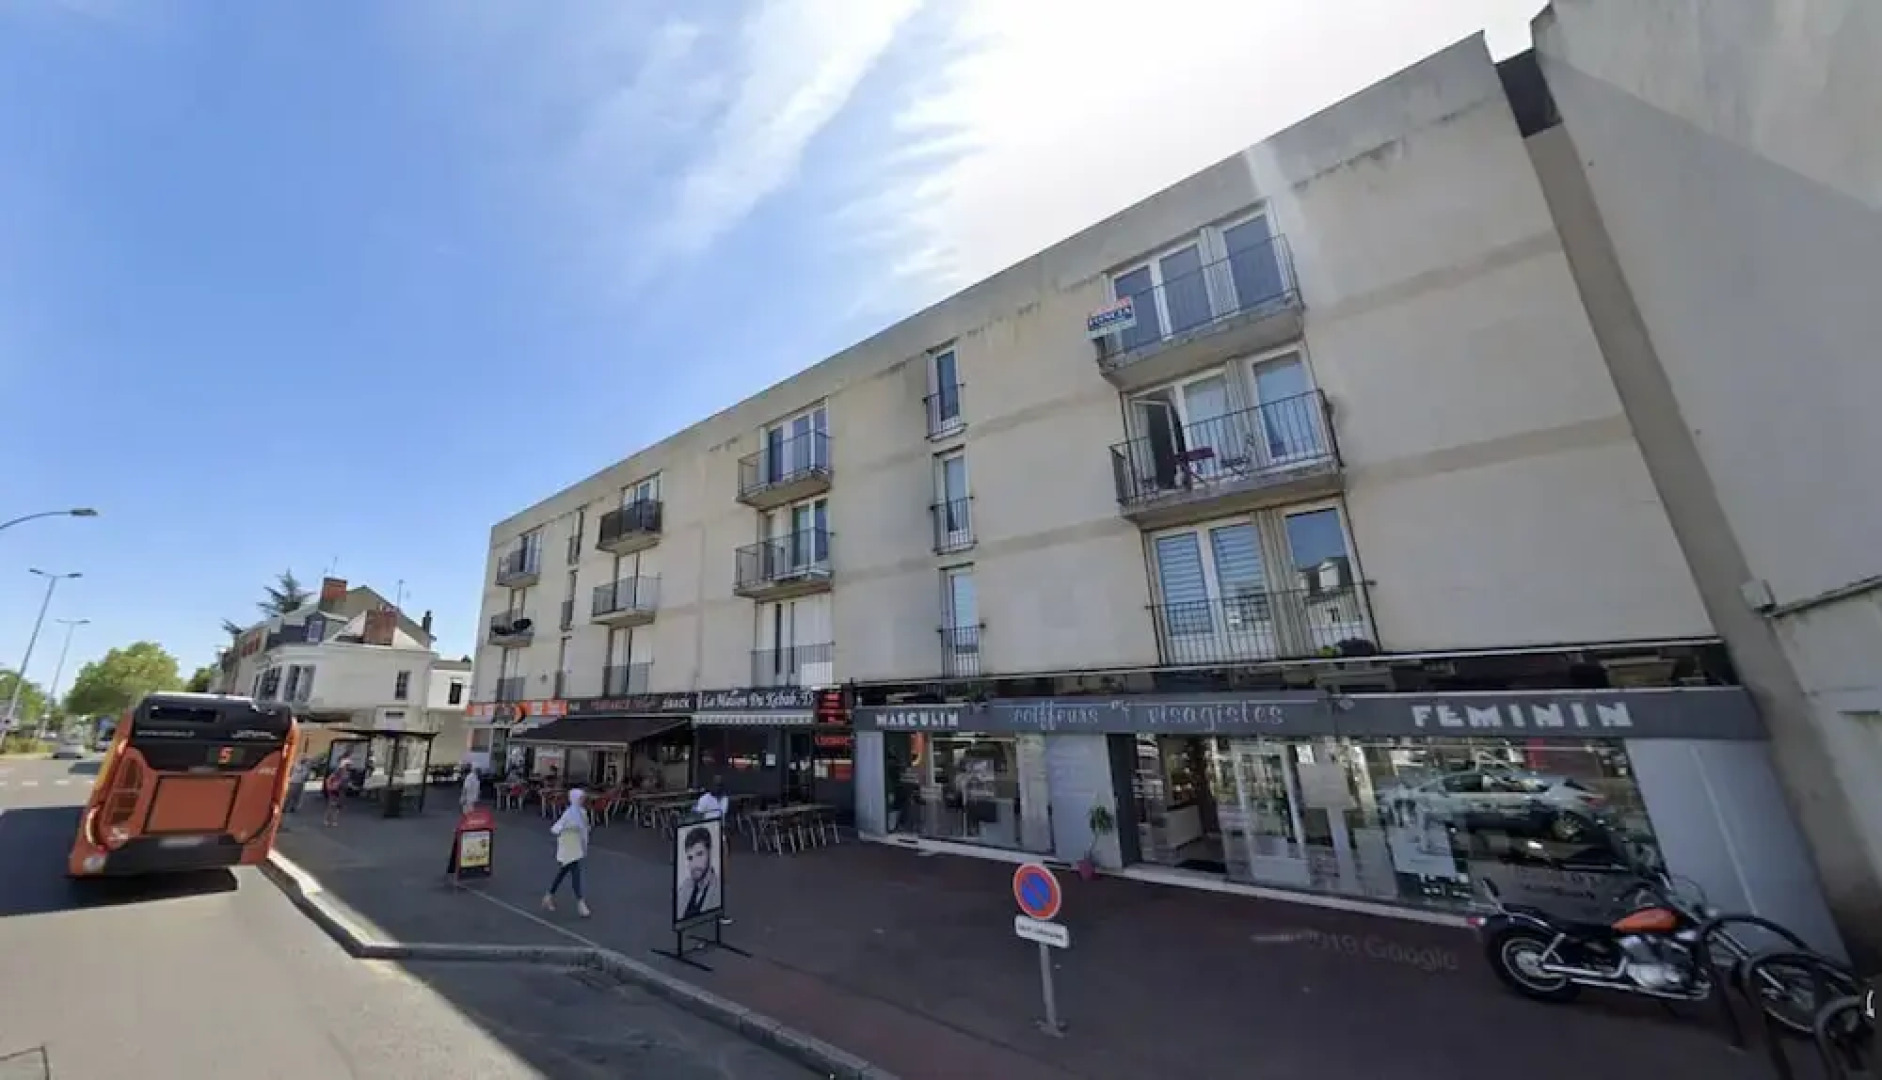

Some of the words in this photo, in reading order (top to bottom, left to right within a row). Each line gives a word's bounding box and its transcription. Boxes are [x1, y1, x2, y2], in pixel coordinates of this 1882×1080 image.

[875, 710, 960, 728] MASCULIN
[1149, 700, 1285, 731] visagistes
[1411, 702, 1634, 728] FEMININ
